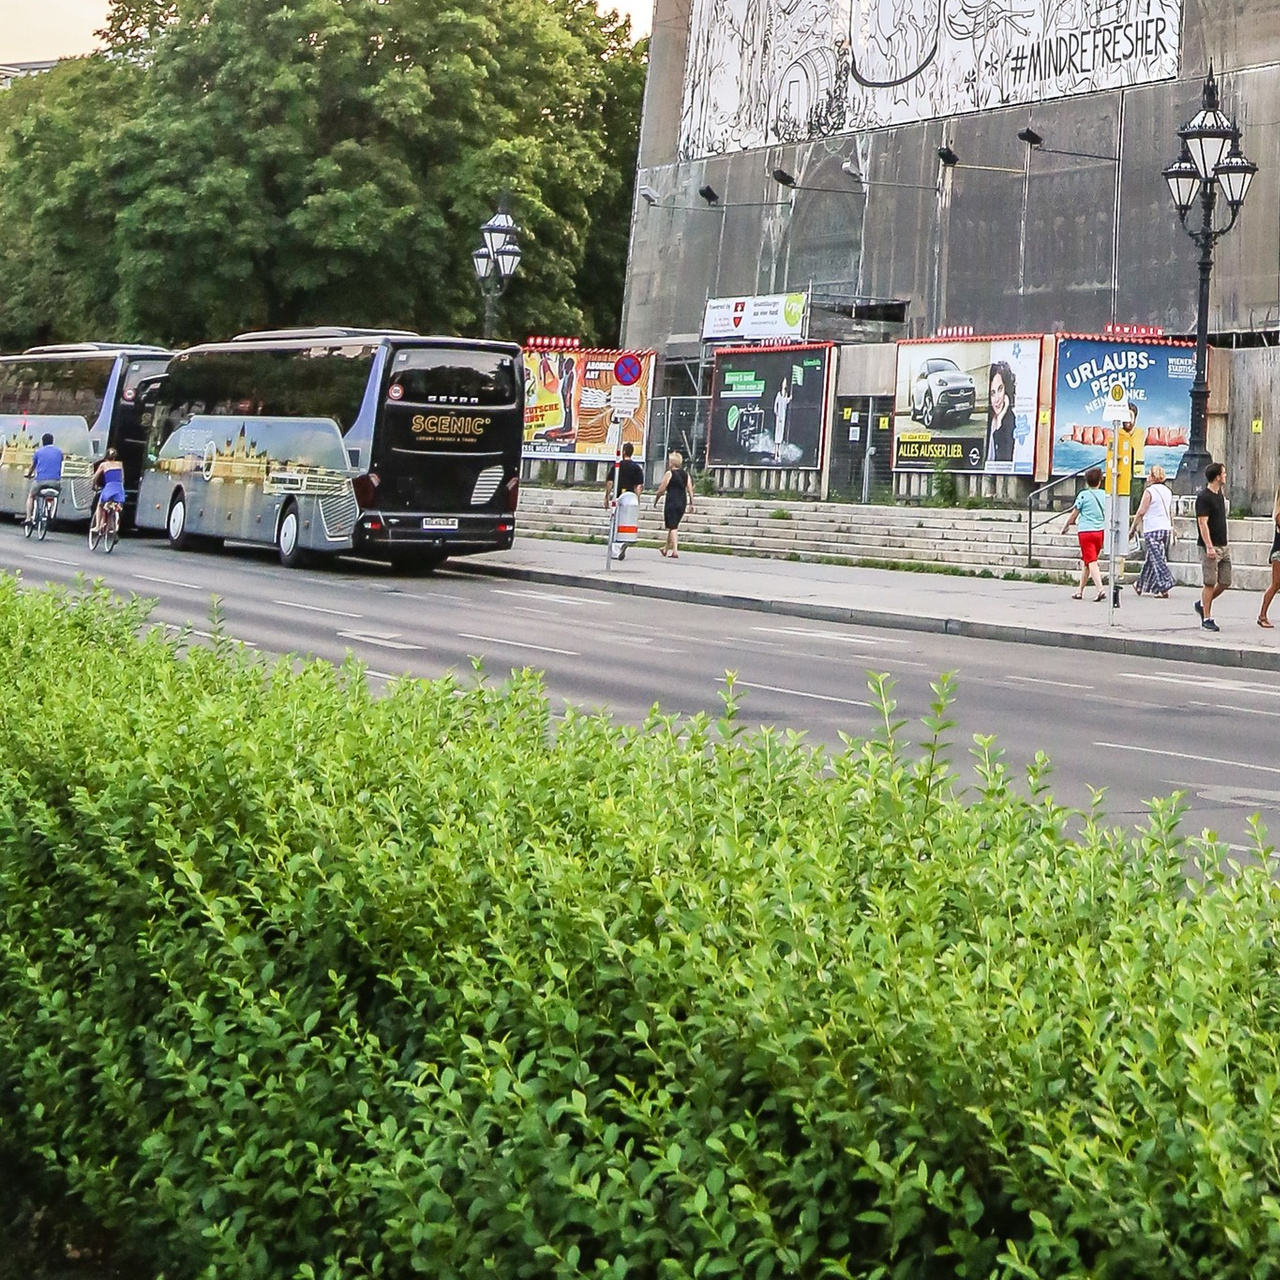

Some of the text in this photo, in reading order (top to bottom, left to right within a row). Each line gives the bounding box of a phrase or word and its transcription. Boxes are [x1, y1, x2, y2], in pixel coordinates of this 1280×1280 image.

[1010, 17, 1168, 86] #MINDREFRESHER
[585, 370, 600, 379] ART
[1066, 351, 1156, 389] URLAUBS-
[1091, 371, 1137, 397] PECH?
[427, 395, 479, 404] SETRA
[525, 403, 559, 415] EUTSCHE
[525, 414, 545, 423] UNST
[898, 443, 964, 458] ALLES AUSSER LIEB.
